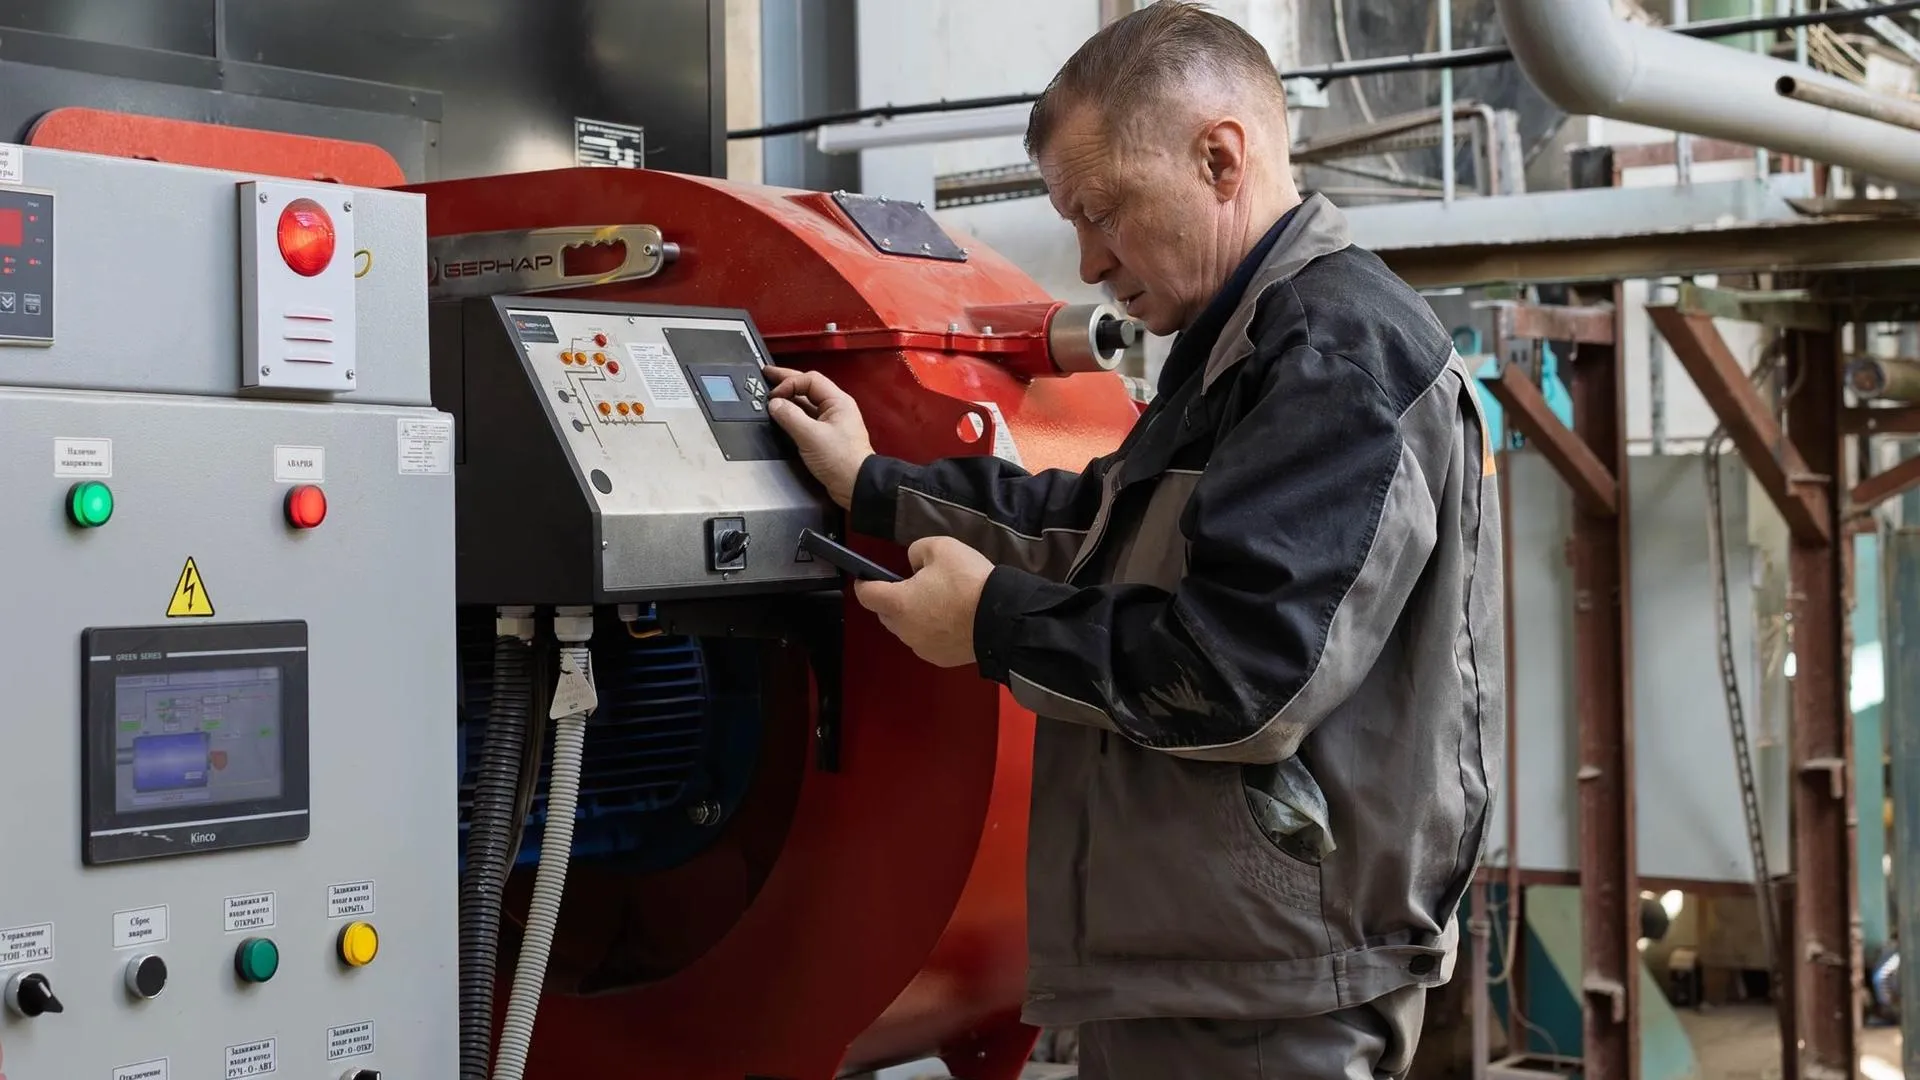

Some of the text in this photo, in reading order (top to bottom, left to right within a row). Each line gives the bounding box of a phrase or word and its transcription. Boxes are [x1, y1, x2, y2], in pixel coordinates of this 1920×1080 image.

[116, 651, 162, 662] GREEN SERIES
[191, 831, 217, 844] Kinco
[338, 904, 365, 914] ЗАКРЫТА
[130, 916, 150, 927] Сброс
[234, 917, 264, 928] ОТКРЫТА
[1, 929, 44, 942] Управление
[10, 940, 36, 950] котлом
[0, 950, 20, 962] ТОП
[26, 946, 49, 959] ПУСК
[228, 1067, 243, 1077] РУЧ
[259, 1061, 273, 1071] АВТ
